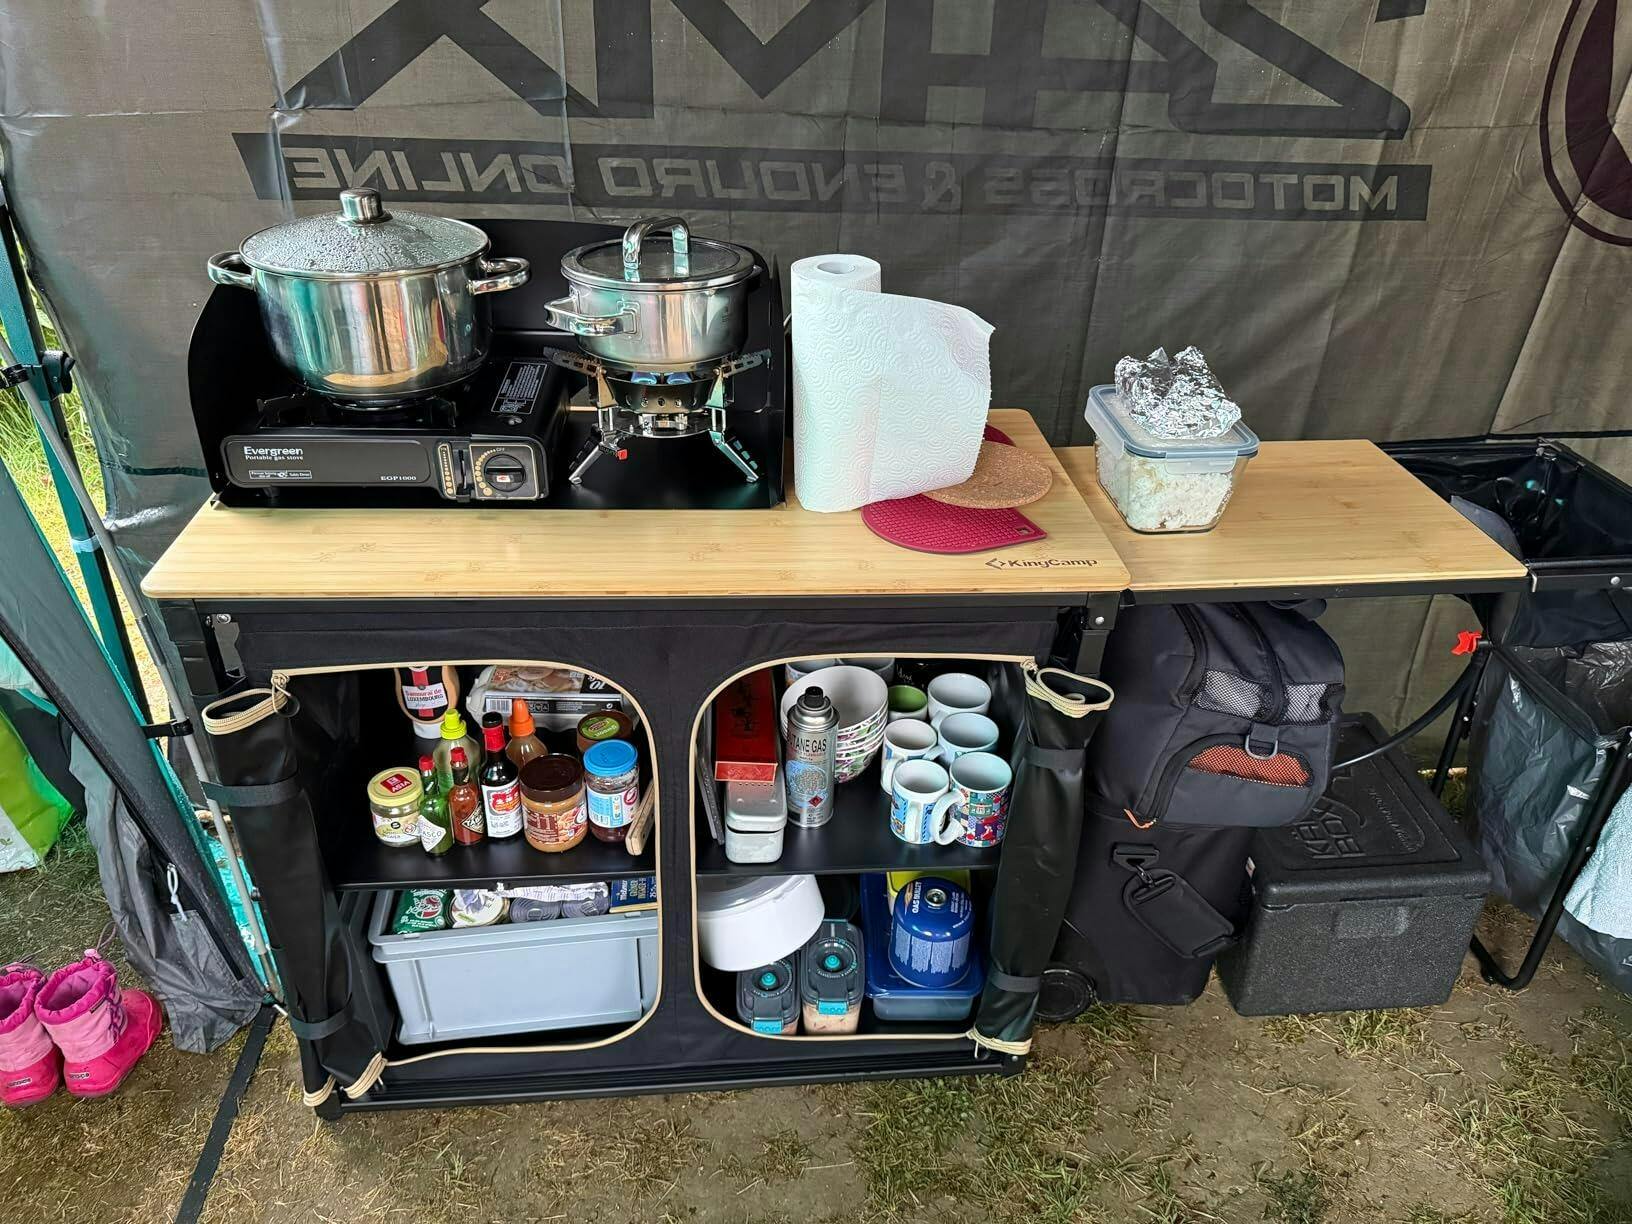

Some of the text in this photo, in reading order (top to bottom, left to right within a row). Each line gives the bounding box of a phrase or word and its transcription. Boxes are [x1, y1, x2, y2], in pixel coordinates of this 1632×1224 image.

[243, 446, 303, 457] Evergreen
[1007, 559, 1098, 568] KingCamp
[810, 738, 827, 753] GAS
[391, 780, 411, 793] ASIA
